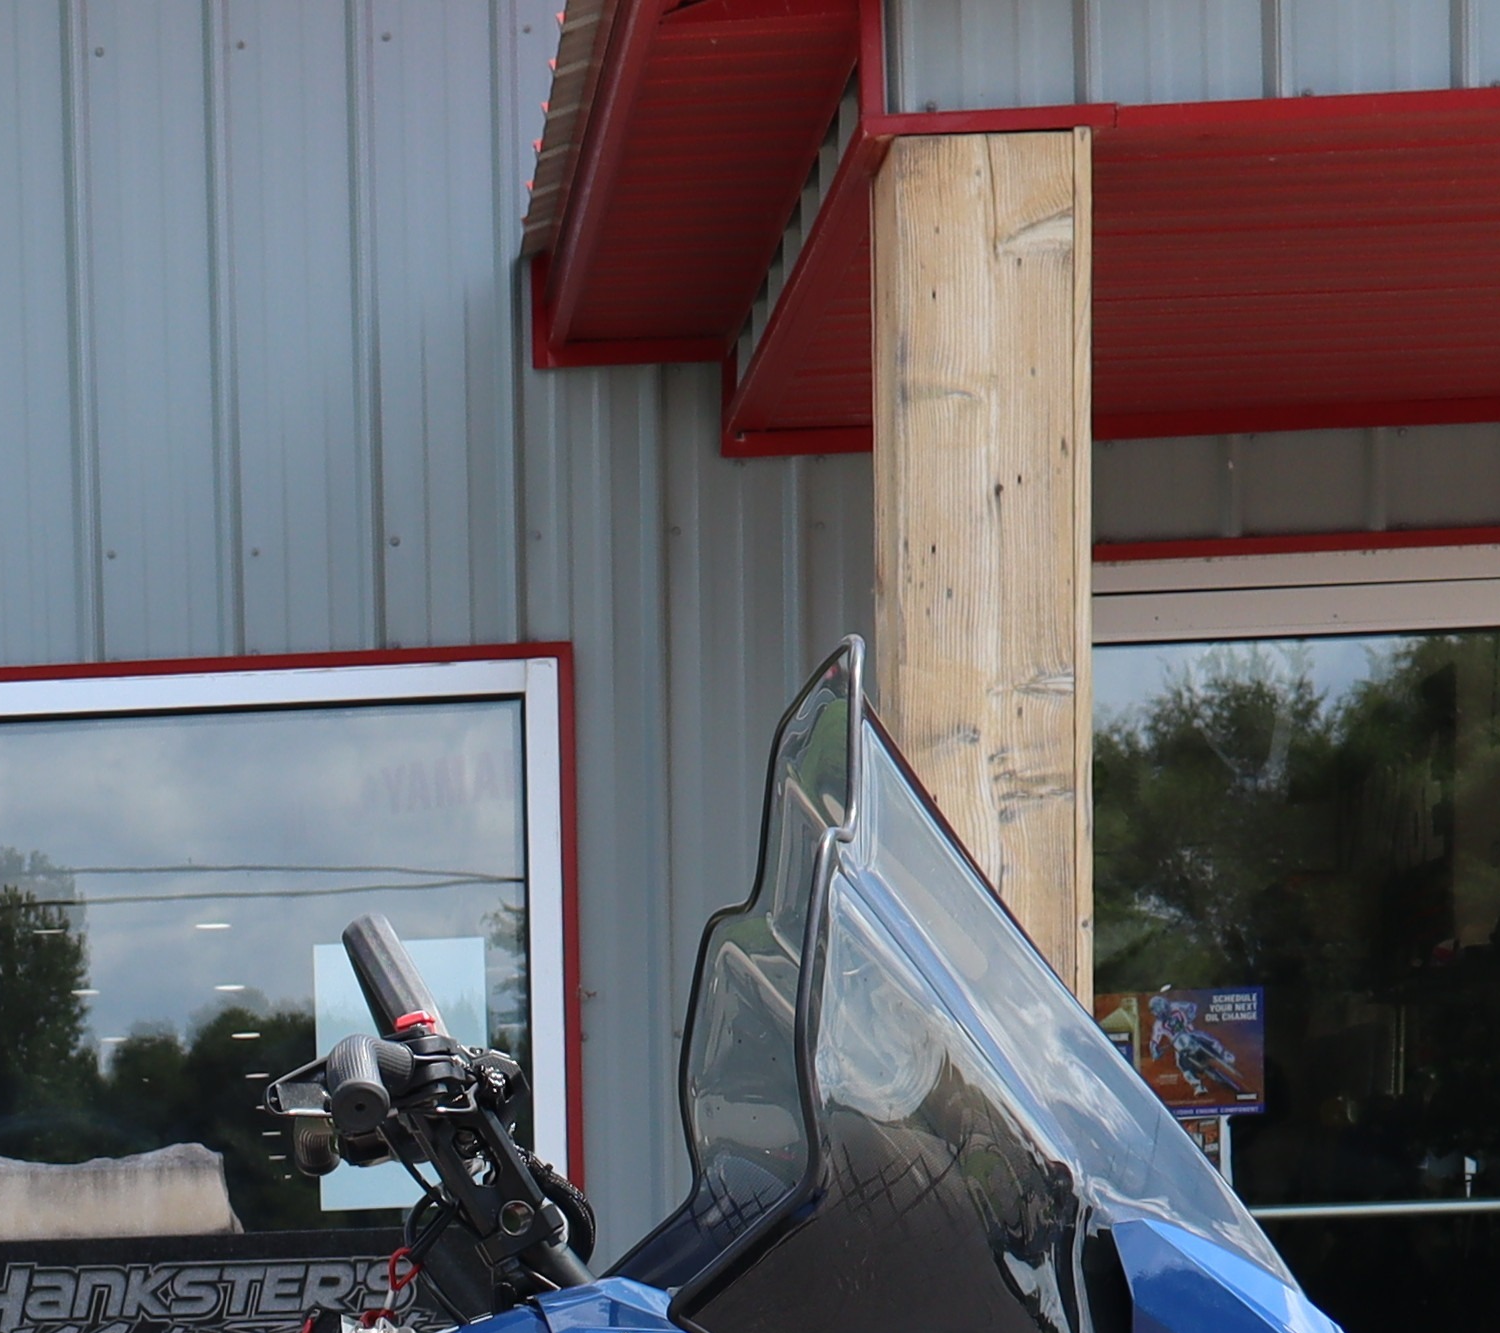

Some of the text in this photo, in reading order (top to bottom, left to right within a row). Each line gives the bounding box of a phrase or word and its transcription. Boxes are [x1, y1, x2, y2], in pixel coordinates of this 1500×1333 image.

[1212, 993, 1257, 1003] SCHEDULE
[1209, 1002, 1257, 1013] YOUR NEXT
[1205, 1012, 1257, 1022] OIL CHANGE
